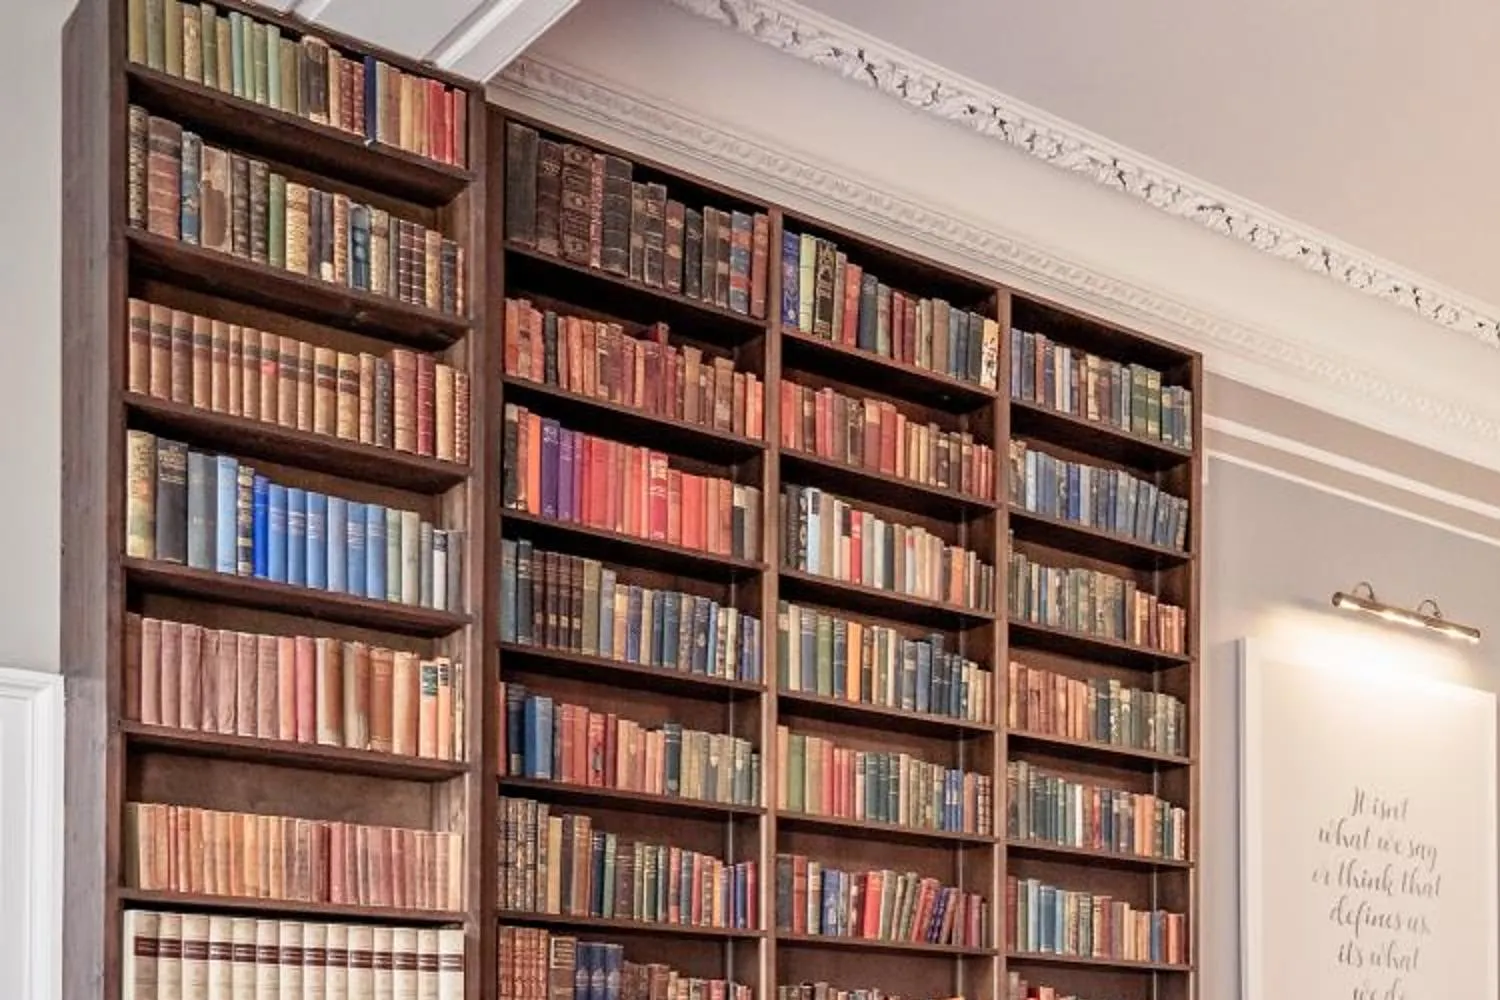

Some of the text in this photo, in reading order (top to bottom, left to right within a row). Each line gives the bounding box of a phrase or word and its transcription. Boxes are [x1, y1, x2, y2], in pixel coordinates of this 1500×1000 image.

[1318, 818, 1438, 873] what we say
[1311, 859, 1441, 898] or think that
[1328, 895, 1401, 940] defines
[1370, 940, 1420, 972] what
